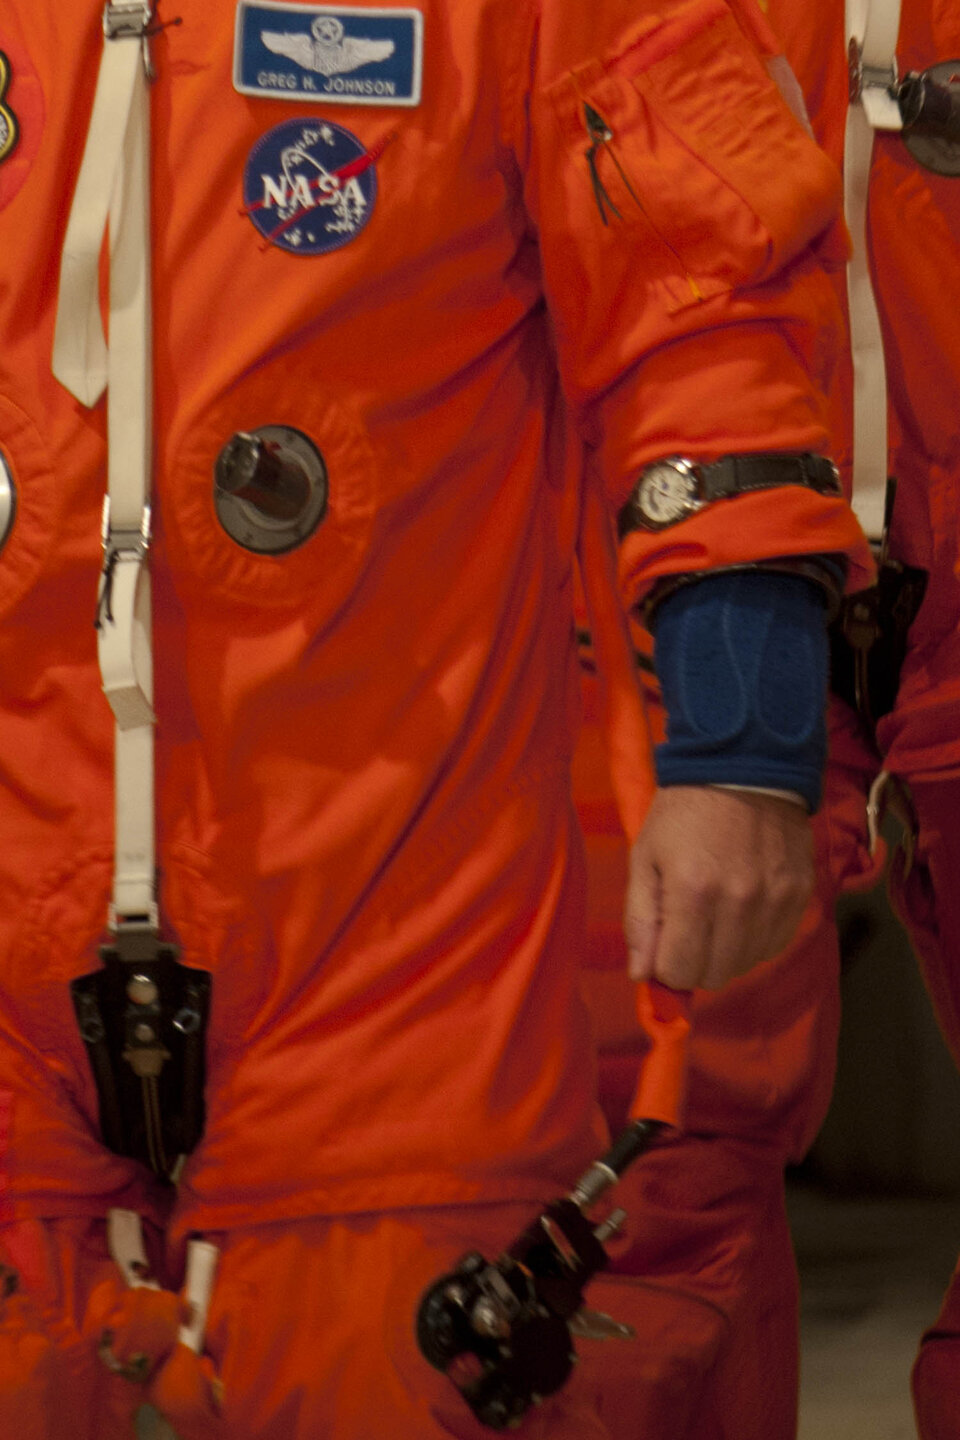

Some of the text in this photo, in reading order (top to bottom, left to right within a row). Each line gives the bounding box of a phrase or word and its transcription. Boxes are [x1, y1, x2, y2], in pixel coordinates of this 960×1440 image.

[257, 71, 298, 89] GREG
[323, 77, 395, 95] JOHNSON
[260, 173, 367, 209] NASA
